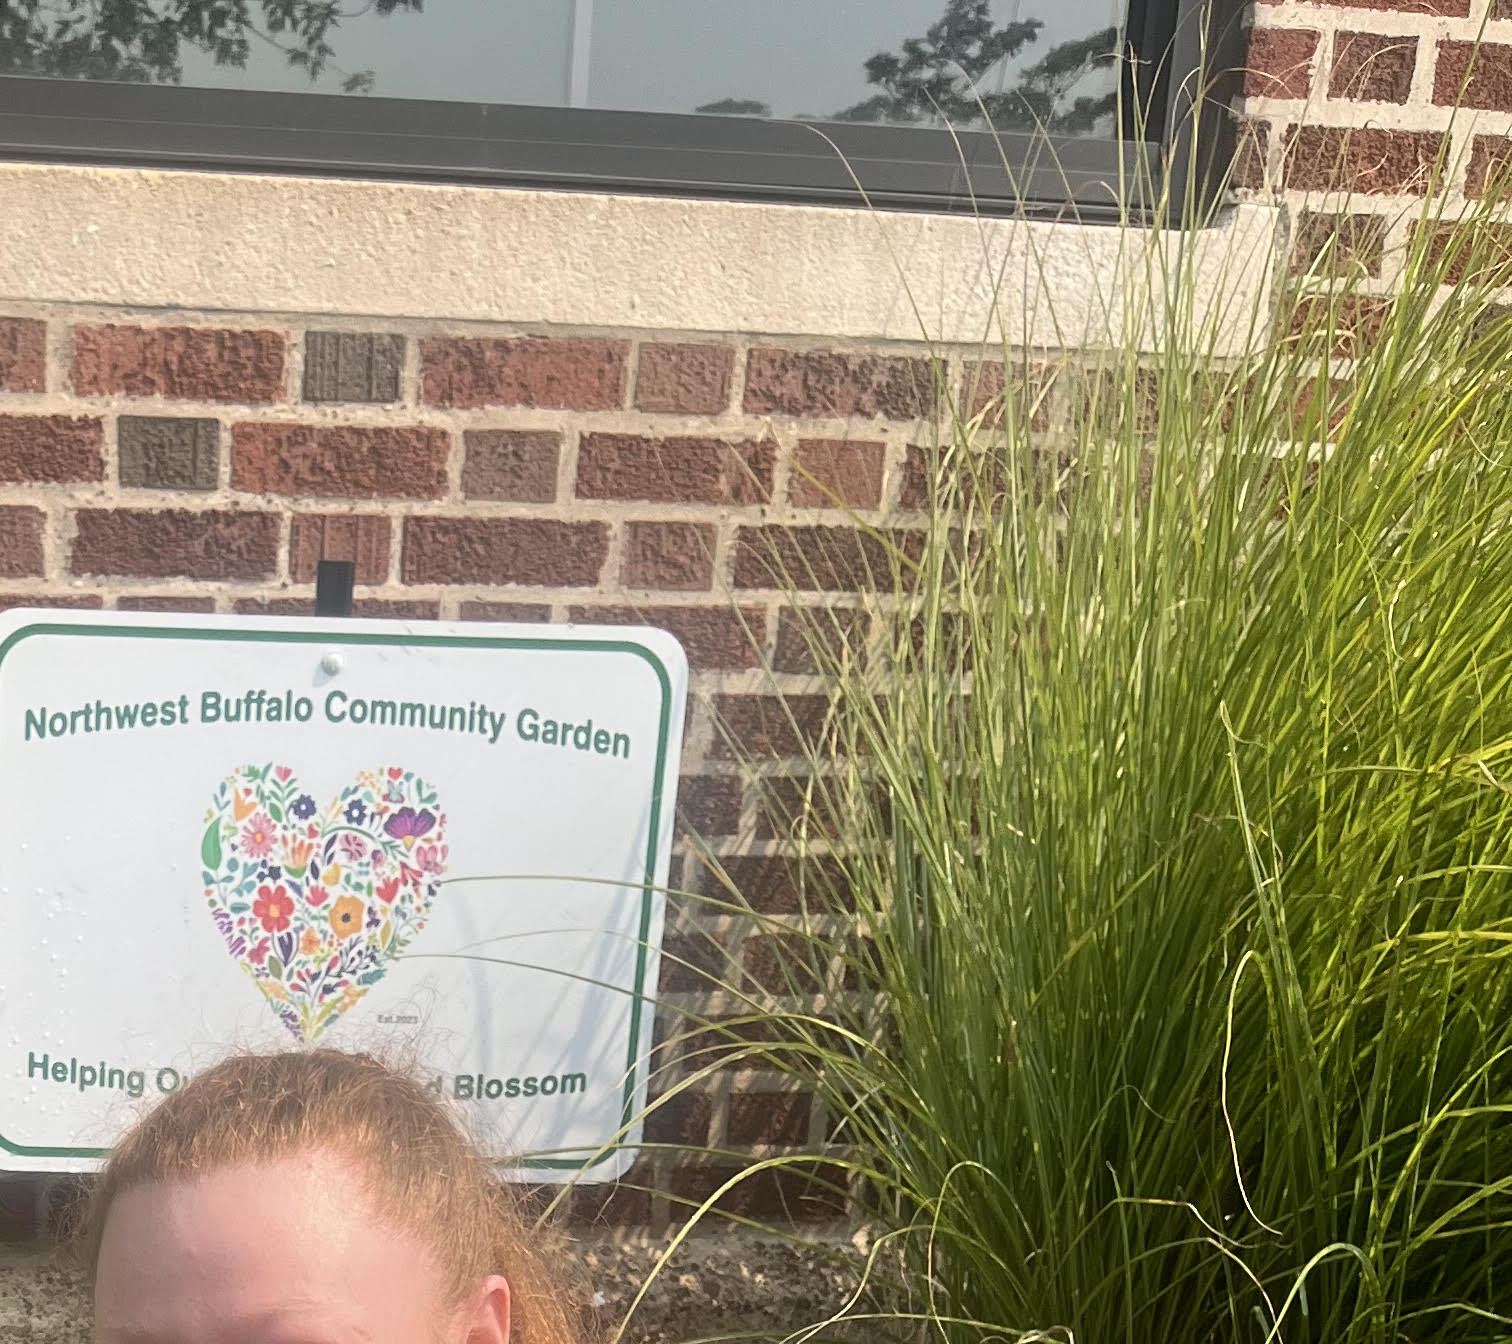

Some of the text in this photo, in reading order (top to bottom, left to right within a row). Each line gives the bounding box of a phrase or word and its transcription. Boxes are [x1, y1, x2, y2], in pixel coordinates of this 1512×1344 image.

[25, 689, 631, 759] Northwest Buffalo Community Garden
[28, 1051, 144, 1098] Helping
[454, 1072, 586, 1100] Blossom
